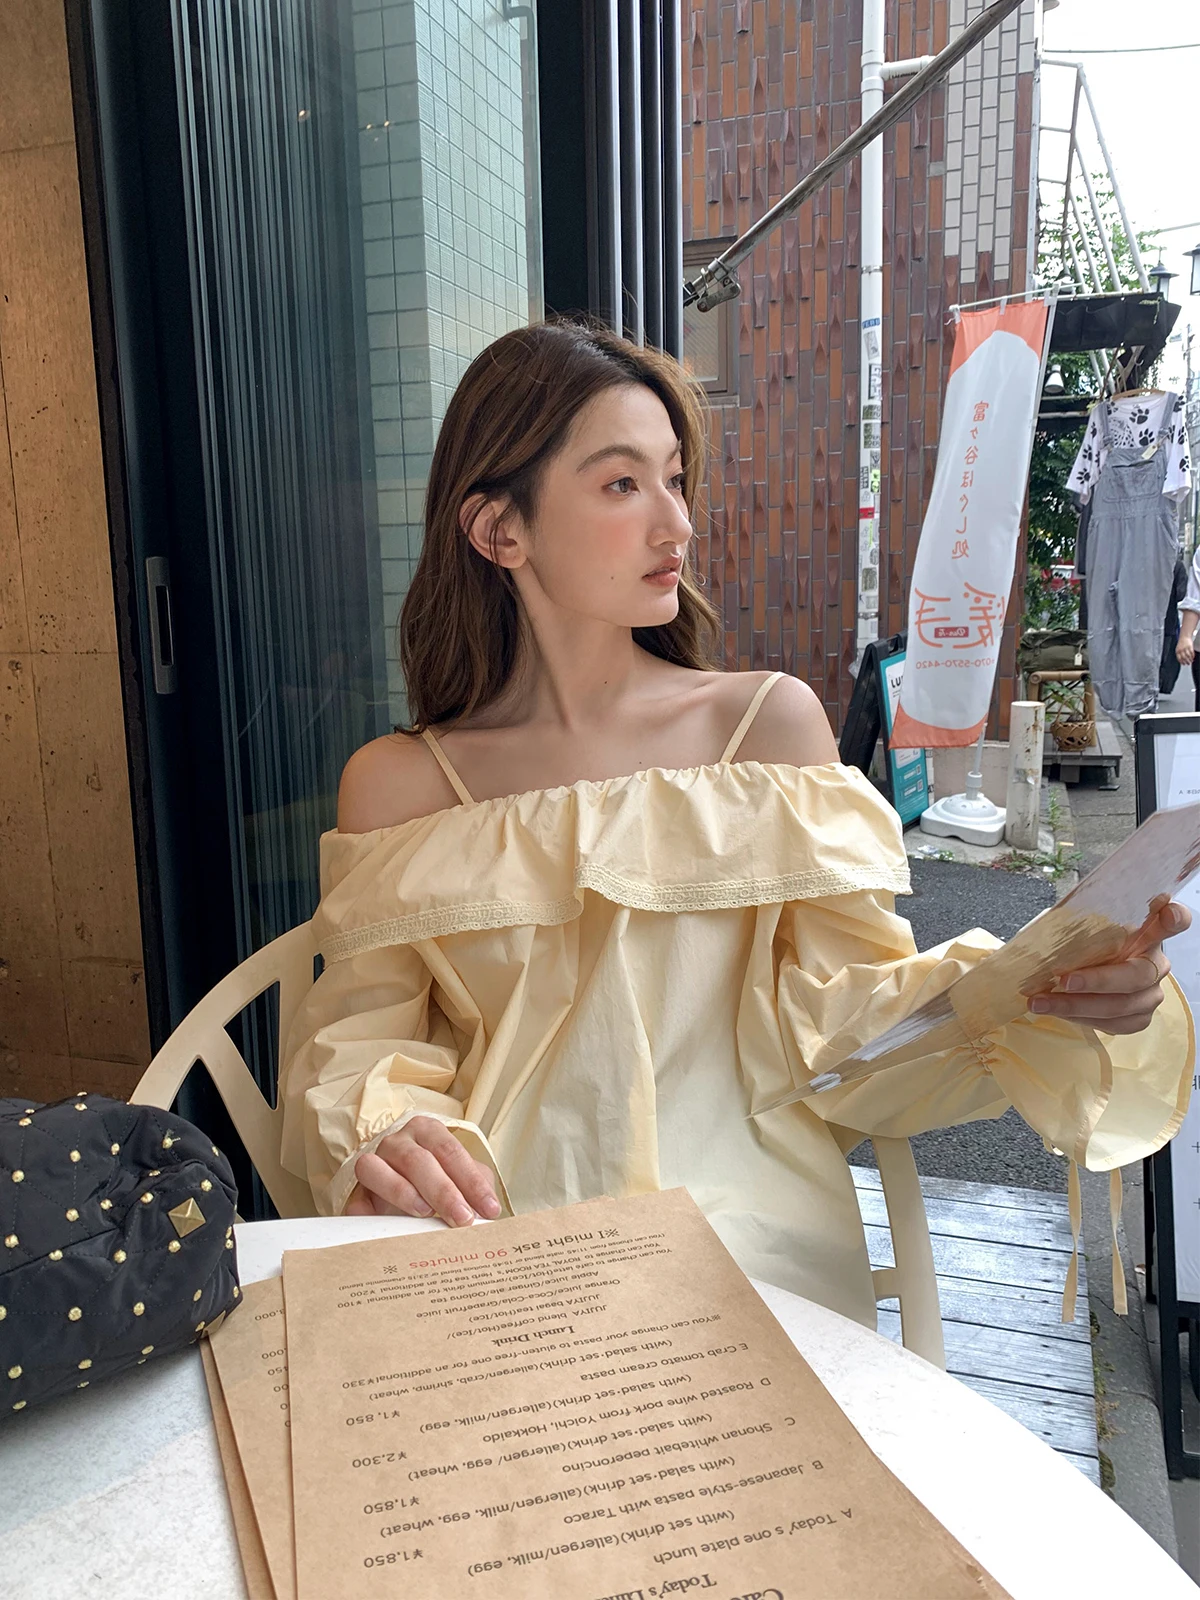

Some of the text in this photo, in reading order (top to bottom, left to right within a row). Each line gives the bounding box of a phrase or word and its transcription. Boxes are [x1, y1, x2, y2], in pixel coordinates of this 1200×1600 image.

[545, 1232, 594, 1248] might
[648, 1232, 666, 1240] (You
[511, 1241, 541, 1254] ask
[607, 1238, 634, 1247] choose
[484, 1248, 508, 1260] 90
[566, 1247, 588, 1255] 11:45
[595, 1248, 626, 1258] change
[638, 1250, 655, 1258] can
[408, 1253, 479, 1269] minutes
[523, 1254, 546, 1262] blend
[551, 1256, 582, 1266] ROYAL
[606, 1254, 638, 1264] change
[440, 1268, 462, 1276] blend
[471, 1271, 493, 1279] Herb
[570, 1270, 599, 1280] Apple
[338, 1282, 364, 1291] blend)
[379, 1282, 425, 1294] additional
[442, 1284, 466, 1293] drink
[584, 1278, 621, 1289] Orange
[366, 1292, 412, 1304] additional
[416, 1309, 442, 1318] juice
[537, 1312, 568, 1323] blend
[630, 1324, 669, 1336] change
[670, 1320, 690, 1329] can
[490, 1325, 576, 1348] Lunch Drink
[572, 1336, 603, 1346] pasta
[605, 1331, 629, 1341] your
[640, 1339, 673, 1351] (with
[494, 1344, 557, 1361] gluten-free
[451, 1361, 469, 1369] for
[471, 1356, 493, 1365] one
[579, 1342, 749, 1381] E Crab tomato cream pasta
[434, 1364, 449, 1372] an
[375, 1367, 432, 1384] additional
[658, 1374, 692, 1388] (with
[412, 1379, 454, 1392] shrimp,
[760, 1377, 772, 1387] D
[368, 1388, 410, 1402] wheat)
[699, 1381, 755, 1401] Roasted
[666, 1394, 699, 1406] wine
[632, 1400, 664, 1414] pork
[598, 1407, 632, 1420] from
[677, 1413, 713, 1428] (with
[419, 1420, 451, 1434] egg)
[482, 1423, 548, 1444] Hokkaido
[561, 1416, 796, 1473] C Shonan whitebait peperoncino
[462, 1458, 493, 1470] egg,
[698, 1455, 736, 1472] (with
[407, 1464, 460, 1482] wheat)
[563, 1459, 824, 1525] B Japanese-style pasta with Taraco
[437, 1511, 471, 1524] egg,
[695, 1509, 735, 1526] (with
[840, 1507, 852, 1519] A
[379, 1518, 435, 1539] wheat)
[667, 1517, 693, 1532] set
[743, 1529, 772, 1544] one
[700, 1536, 741, 1553] plate
[652, 1546, 698, 1565] lunch
[467, 1560, 503, 1578] egg)
[648, 1573, 717, 1599] Today's
